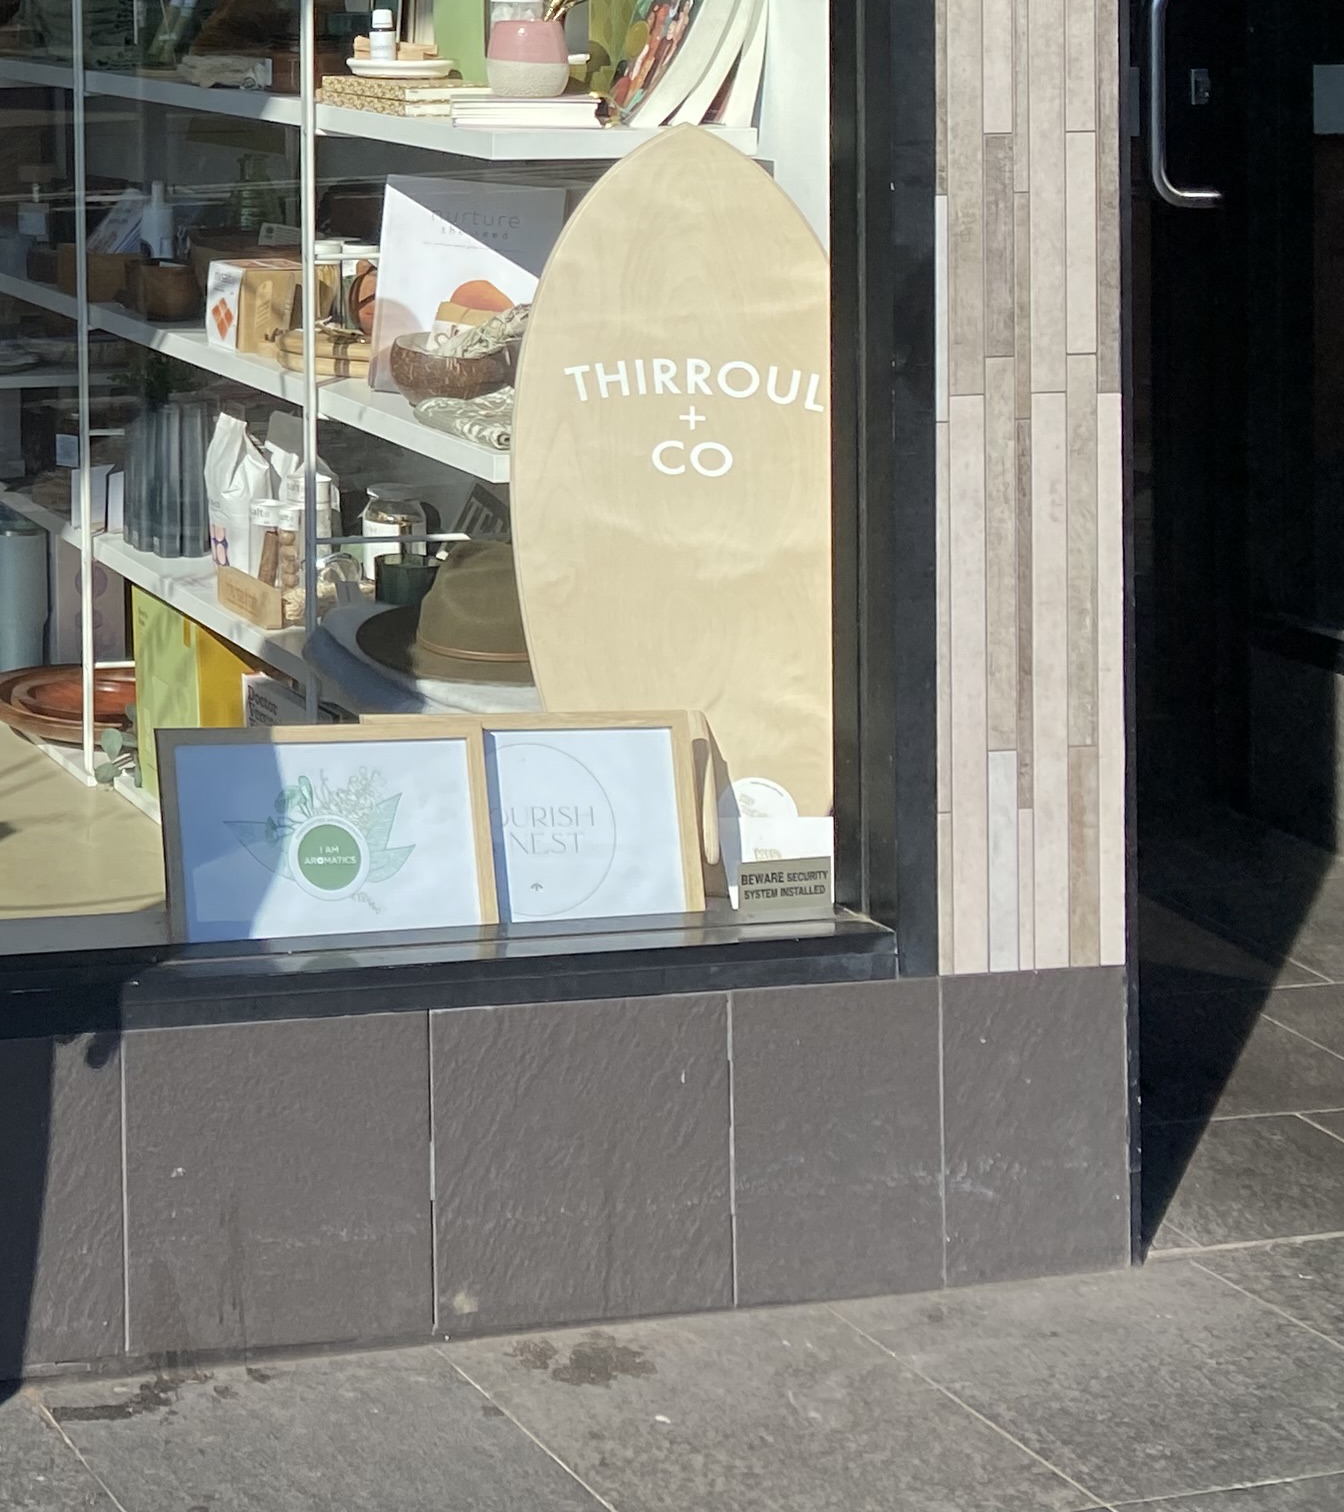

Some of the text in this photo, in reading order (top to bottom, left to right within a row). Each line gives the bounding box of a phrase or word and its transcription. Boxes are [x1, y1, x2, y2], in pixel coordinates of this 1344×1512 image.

[564, 358, 824, 412] THIRROUL
[679, 405, 706, 430] +
[651, 440, 733, 477] CO
[325, 846, 340, 854] AM
[510, 832, 584, 854] NEST
[304, 855, 357, 865] AROMATICS
[741, 870, 829, 886] BEWARE SECURITY
[744, 884, 826, 900] SYSTEM INSTALLED
